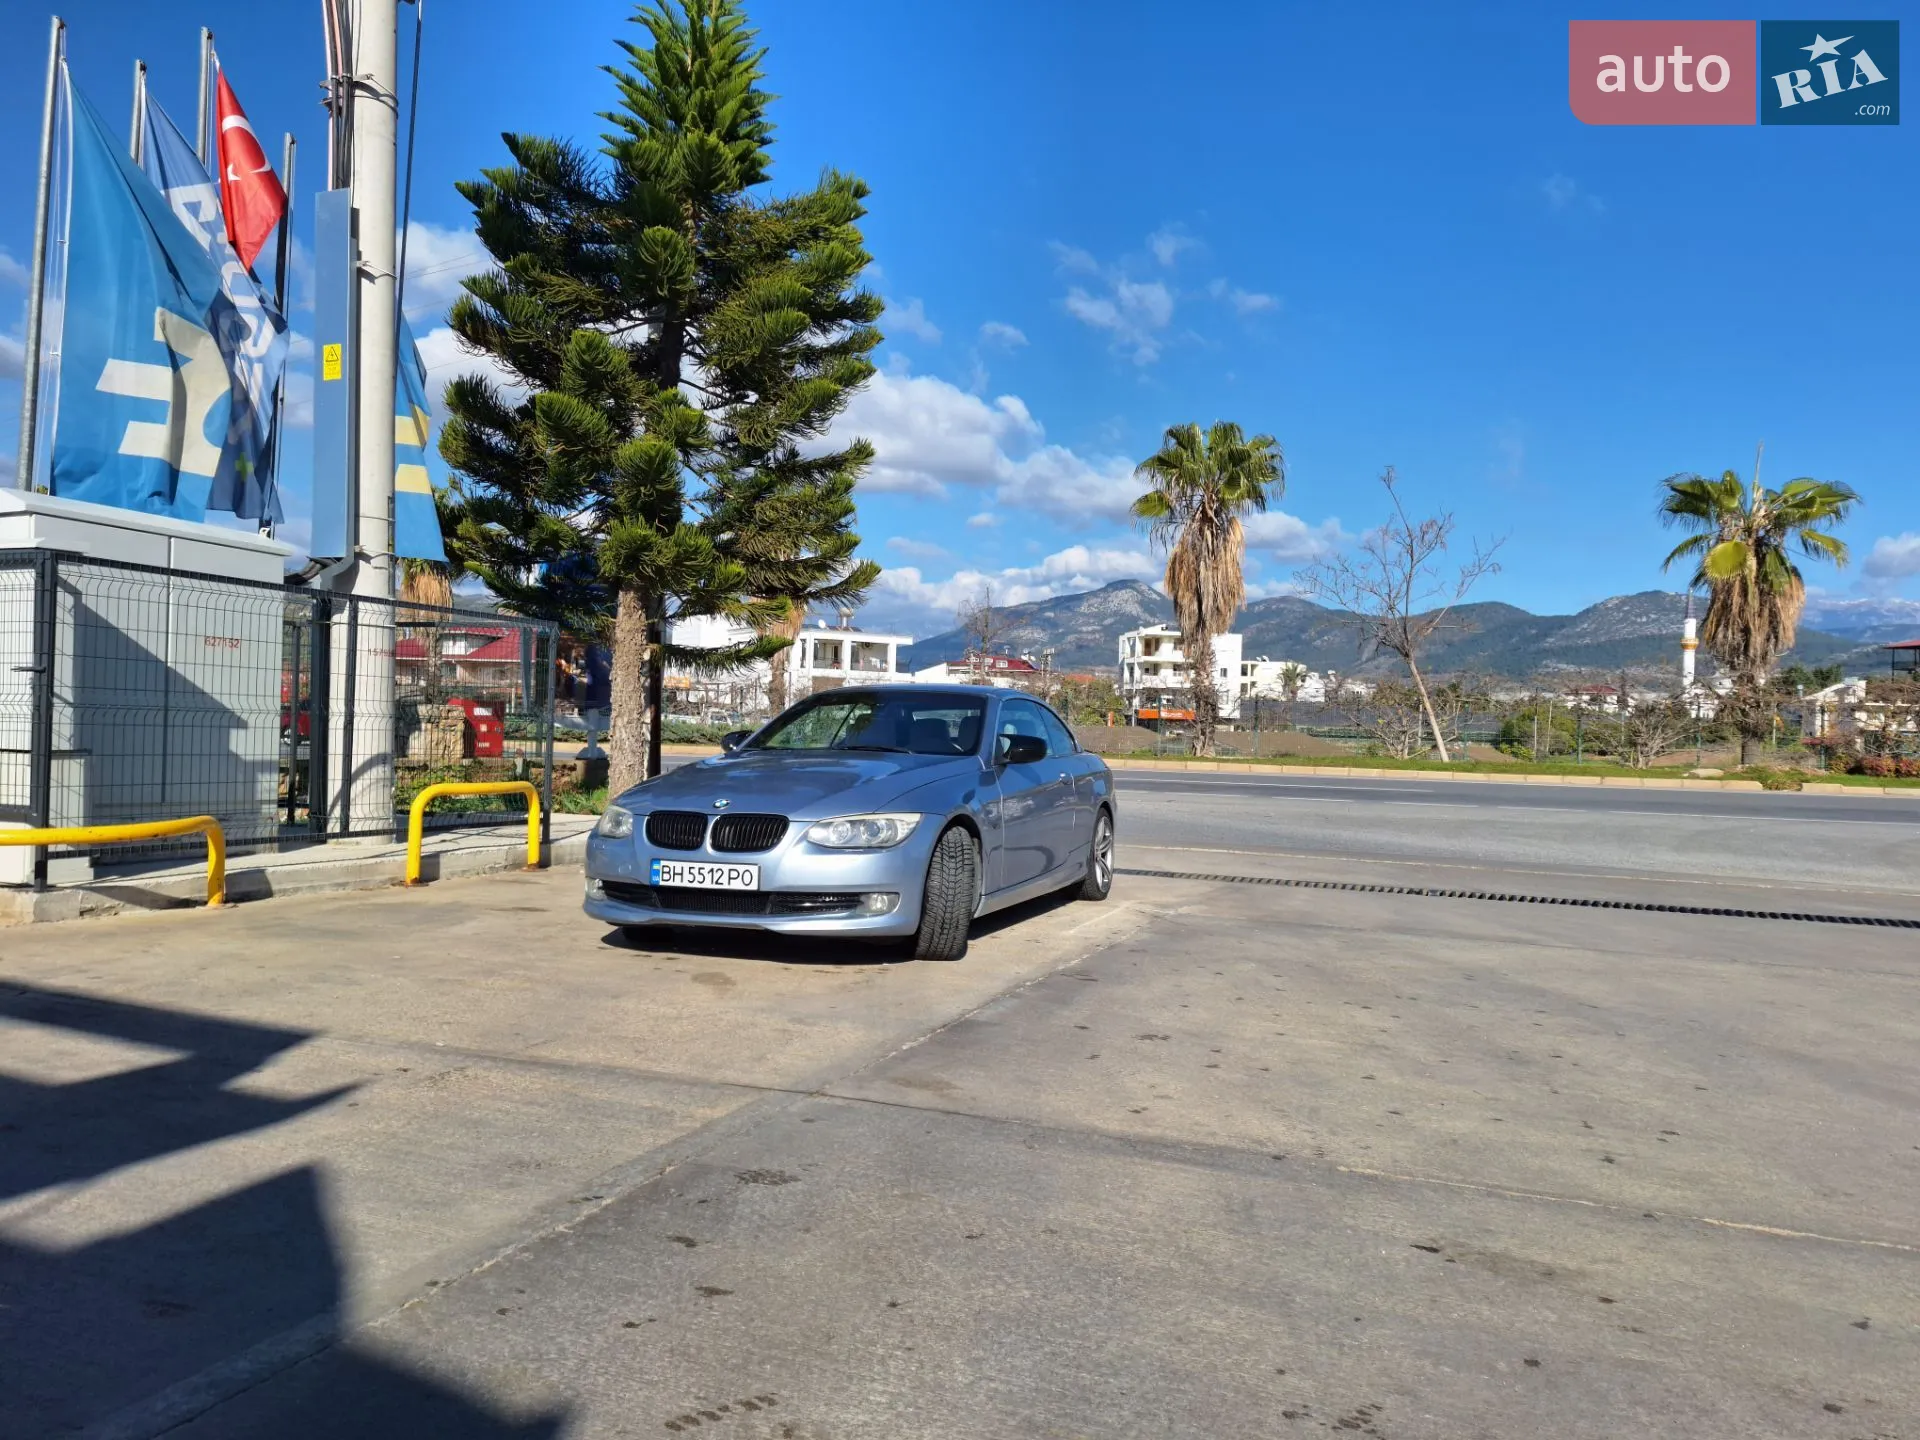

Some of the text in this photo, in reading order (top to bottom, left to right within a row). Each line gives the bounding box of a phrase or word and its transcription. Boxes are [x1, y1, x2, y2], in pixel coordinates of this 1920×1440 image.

[661, 864, 753, 887] BH 5512 PO
